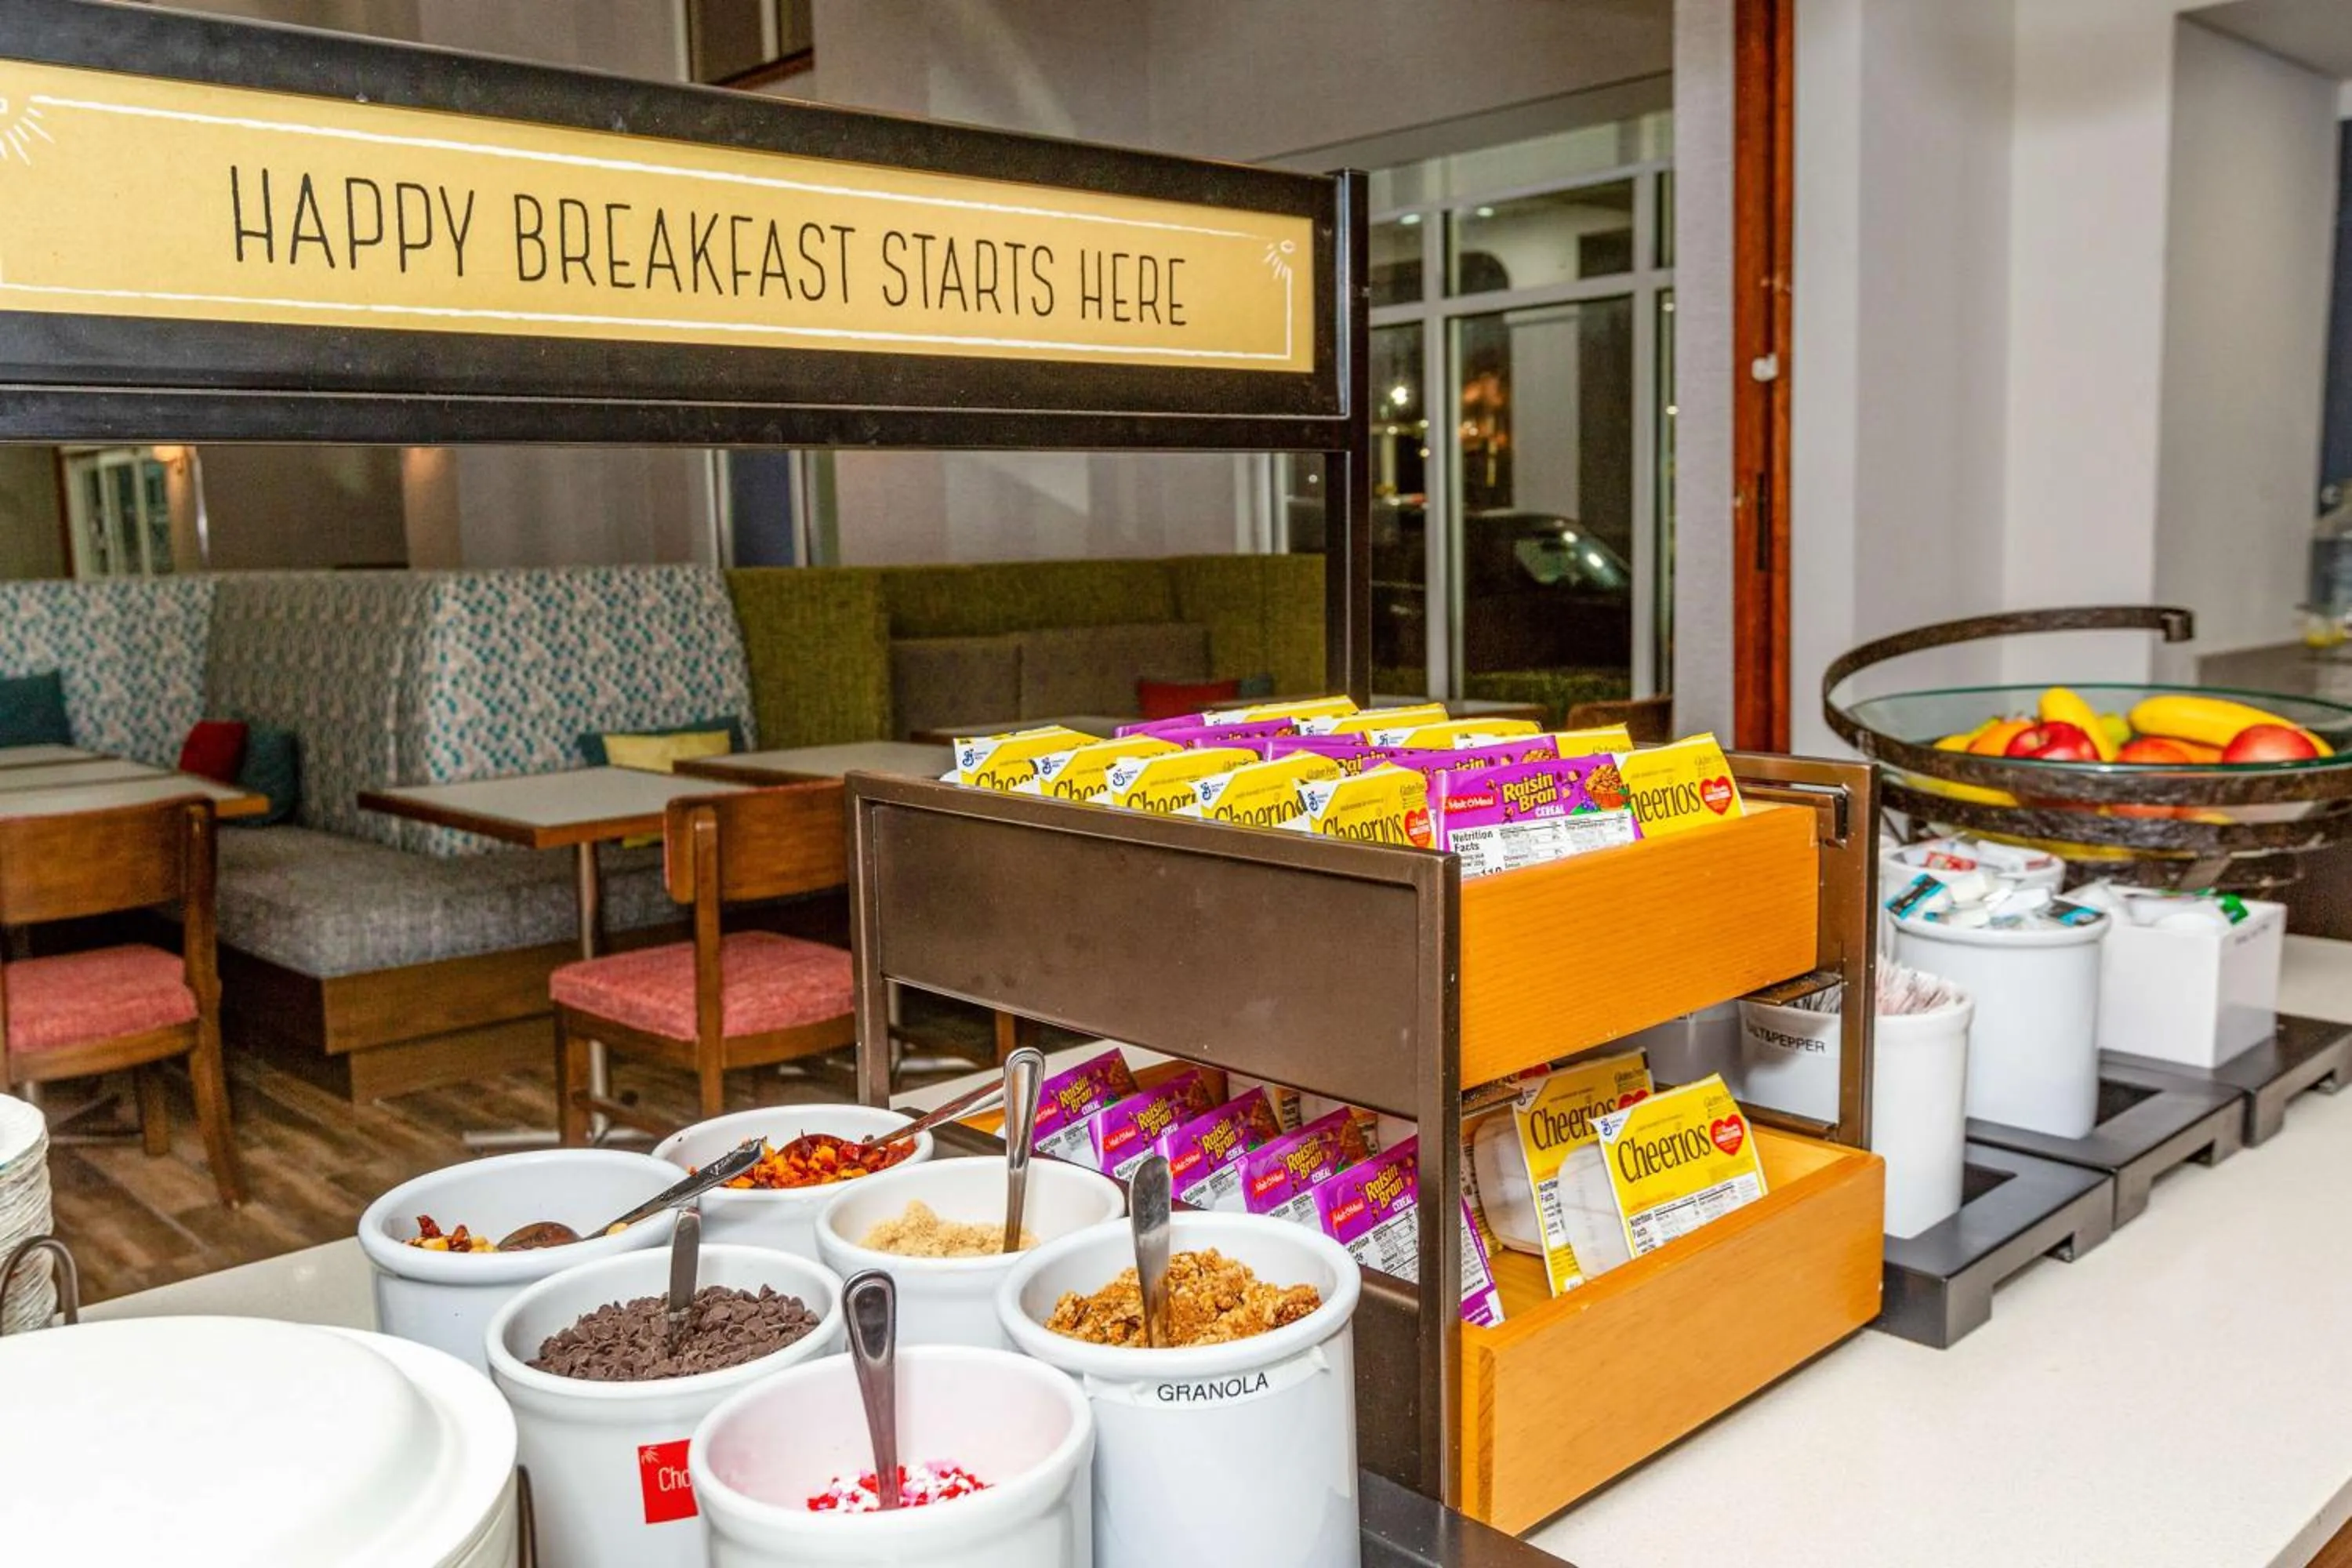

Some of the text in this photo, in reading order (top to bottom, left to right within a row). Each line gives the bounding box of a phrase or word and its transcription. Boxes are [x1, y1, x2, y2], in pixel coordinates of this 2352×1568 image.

[230, 165, 1187, 326] HAPPY BREAKFAST STARTS HERE
[1502, 771, 1554, 804] Raisin
[1519, 787, 1559, 813] Bran
[1625, 782, 1701, 823] heerios
[1534, 804, 1566, 818] CEREAL
[1452, 829, 1494, 843] Nutrition
[1059, 1076, 1089, 1109] Raisin
[1071, 1087, 1092, 1113] Bran
[1138, 1098, 1167, 1131] Raisin
[1202, 1118, 1232, 1155] Raisin
[1214, 1130, 1236, 1160] Bran
[1287, 1138, 1318, 1174] Raisin
[1299, 1150, 1323, 1180] Bran
[1617, 1124, 1712, 1184] Cheerios
[1365, 1163, 1399, 1203] Raisin
[1379, 1177, 1404, 1210] Bran
[1156, 1371, 1269, 1402] GRANOLA
